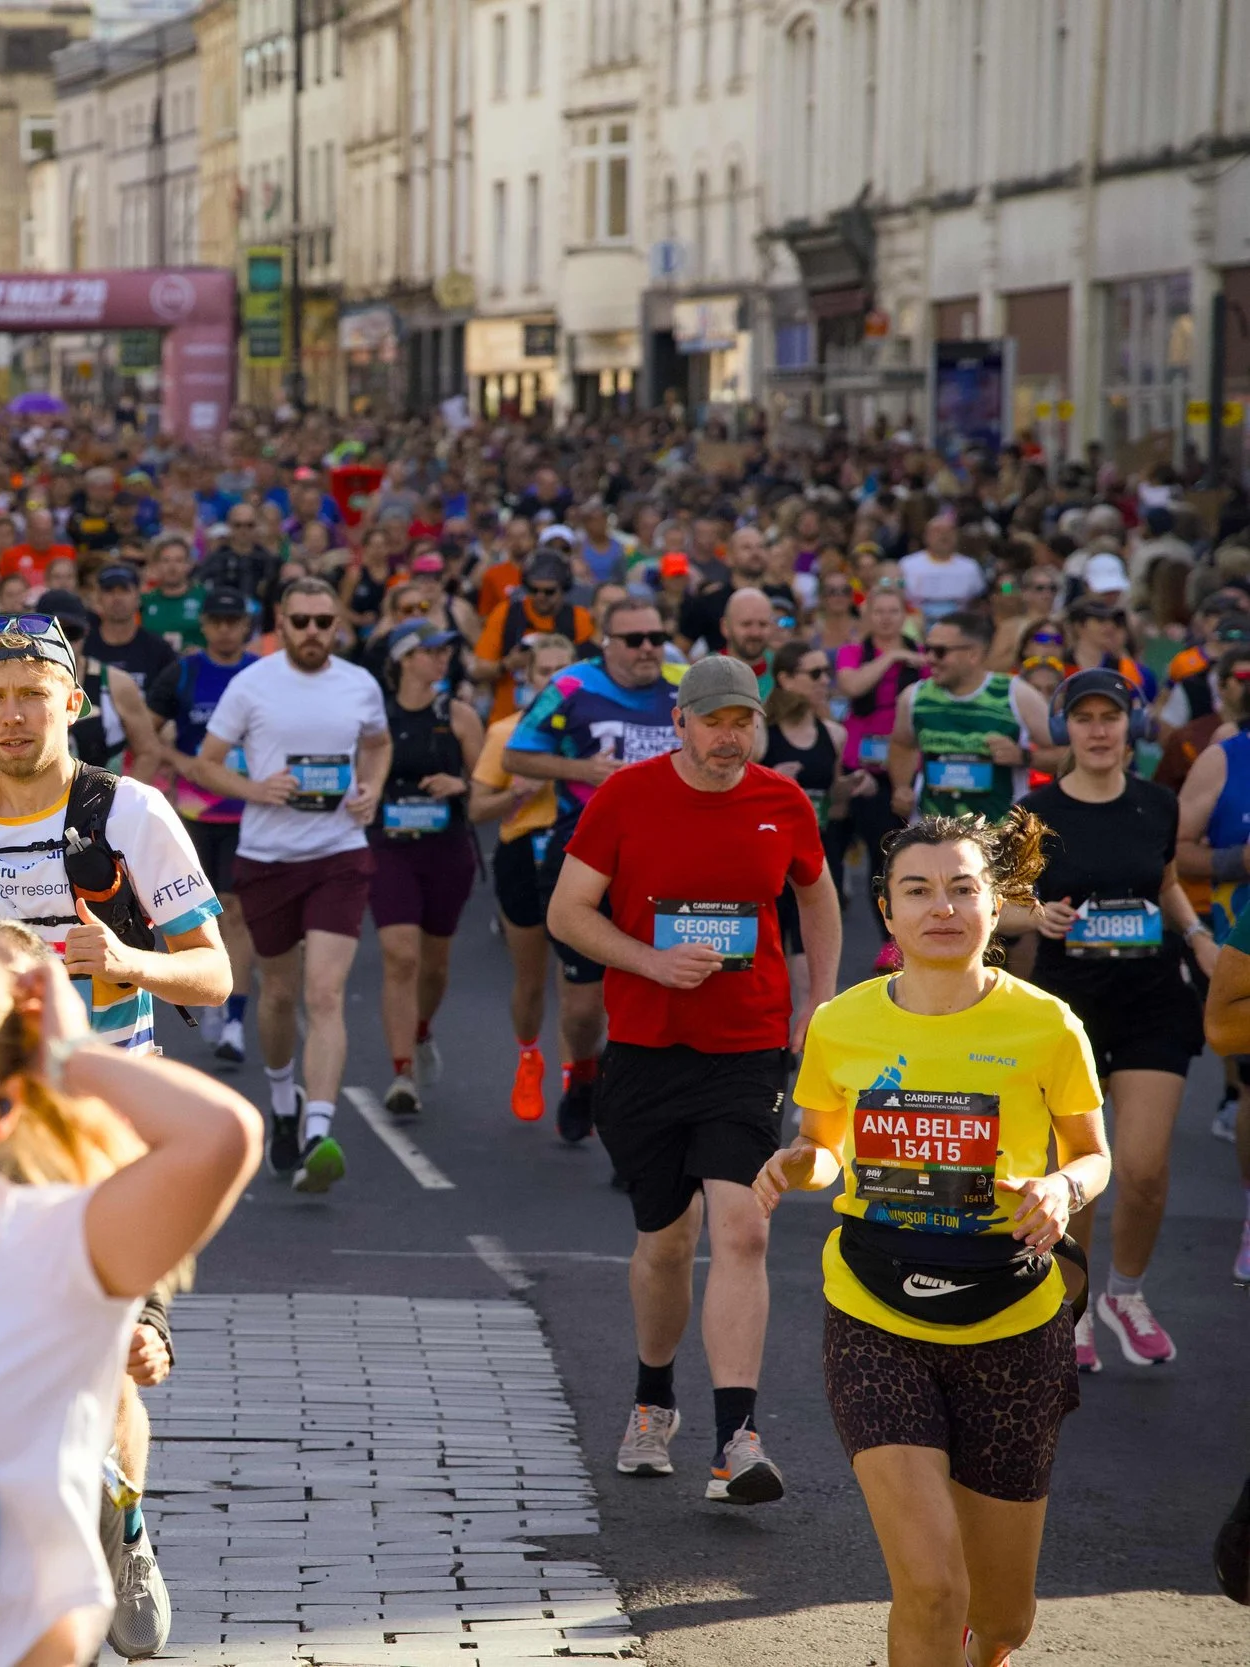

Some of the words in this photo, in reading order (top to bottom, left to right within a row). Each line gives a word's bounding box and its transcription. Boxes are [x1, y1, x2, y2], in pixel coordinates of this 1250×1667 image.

[693, 902, 720, 910] CARDIFF
[674, 918, 740, 935] GEORGE
[968, 1052, 1017, 1067] RUNFACE
[904, 1093, 943, 1104] CARDIFF
[945, 1095, 971, 1105] HALF
[862, 1114, 909, 1136] ANA
[915, 1117, 991, 1140] BELEN
[891, 1138, 961, 1162] 15415
[963, 1194, 989, 1203] 15415
